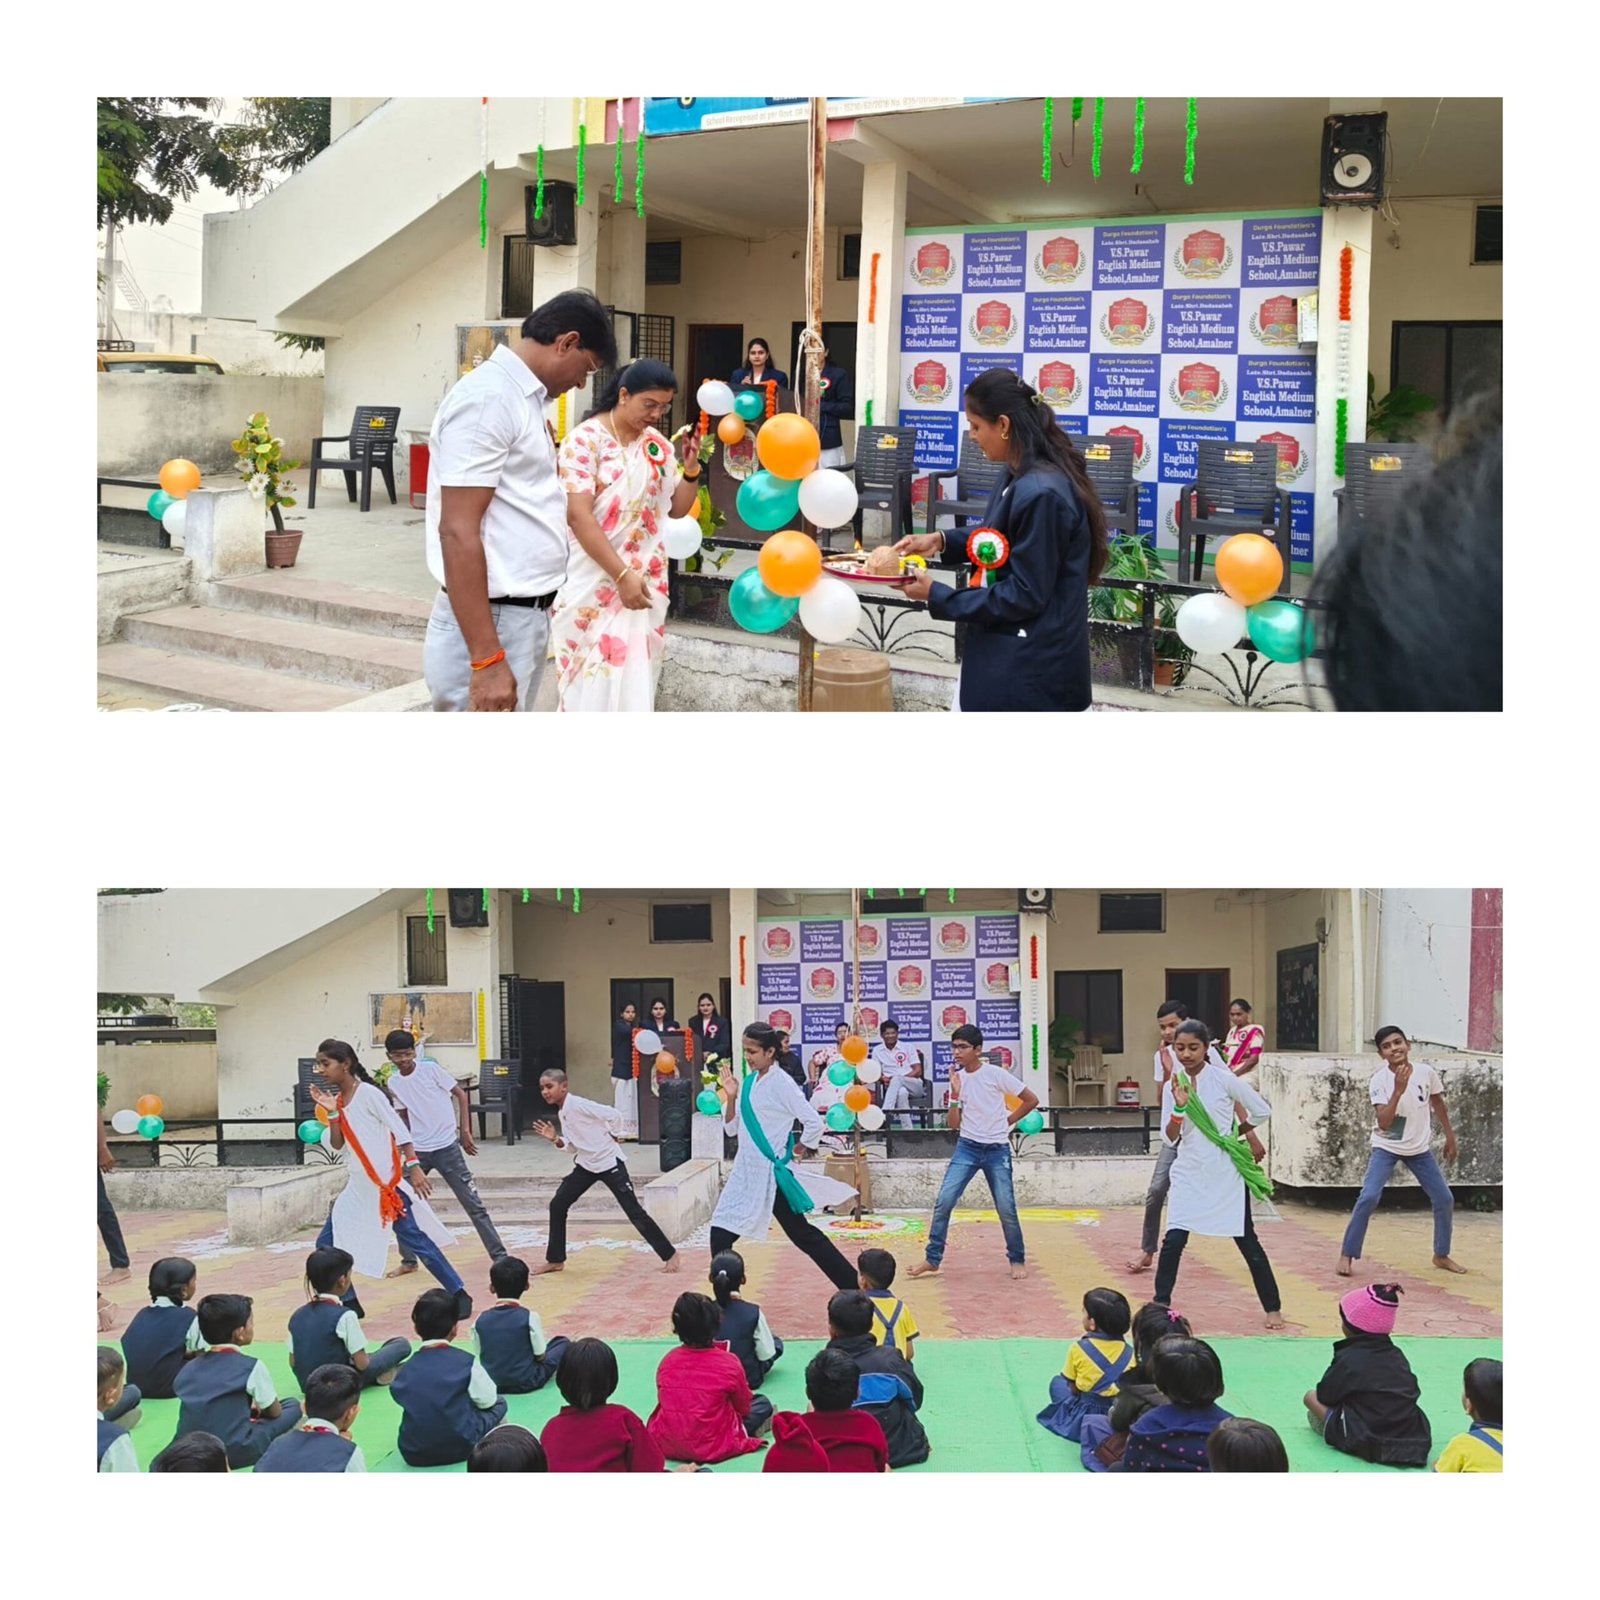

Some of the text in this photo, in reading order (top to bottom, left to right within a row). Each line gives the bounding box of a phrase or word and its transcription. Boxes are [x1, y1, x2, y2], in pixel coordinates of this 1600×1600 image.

[1110, 248, 1149, 258] V.S.Pawar
[1262, 242, 1305, 253] V.S.Pawar
[978, 253, 1012, 263] V.S.Pawar
[1247, 254, 1318, 268] English Medium
[967, 264, 1022, 276] English Medium
[1098, 259, 1160, 272] English Medium
[916, 314, 947, 324] V.S.Pawar
[1040, 313, 1076, 323] V.S.Pawar
[1181, 311, 1222, 322] V.S.Pawar
[905, 325, 957, 337] English Medium
[1029, 324, 1087, 336] English Medium
[1167, 323, 1234, 336] English Medium
[1106, 375, 1144, 385] V.S.Pawar
[1257, 378, 1300, 389] V.S.Pawar
[1094, 387, 1156, 399] English Medium
[1243, 391, 1314, 404] English Medium
[917, 430, 944, 440] .S.Pawar
[928, 442, 954, 452] Medium
[914, 454, 952, 464] ool,Amalner
[1164, 454, 1194, 466] English
